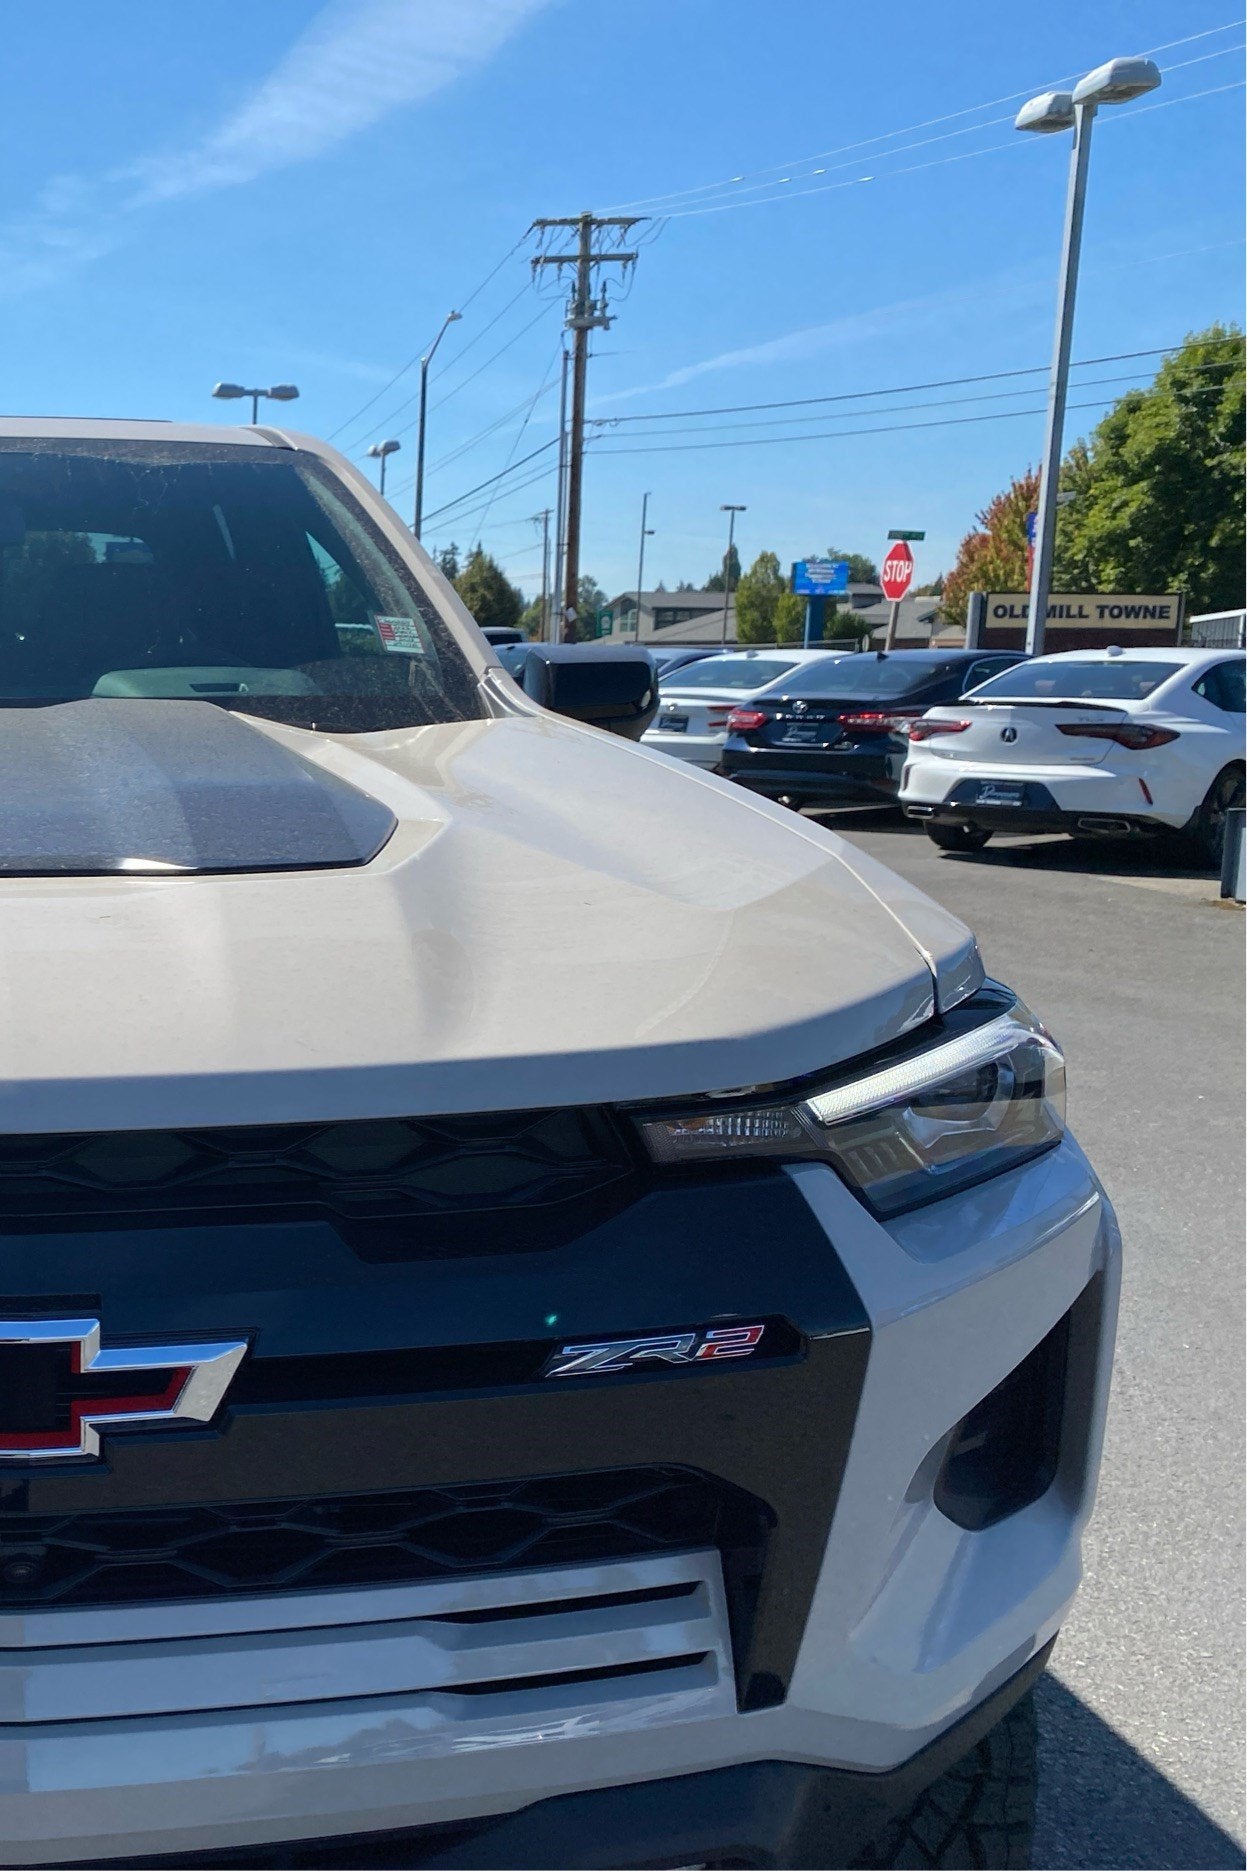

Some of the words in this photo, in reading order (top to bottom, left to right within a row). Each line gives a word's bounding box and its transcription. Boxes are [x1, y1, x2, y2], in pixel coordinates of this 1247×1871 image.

[884, 560, 912, 582] STOP
[1096, 604, 1171, 619] TOWNE
[545, 1324, 765, 1378] ZR2
